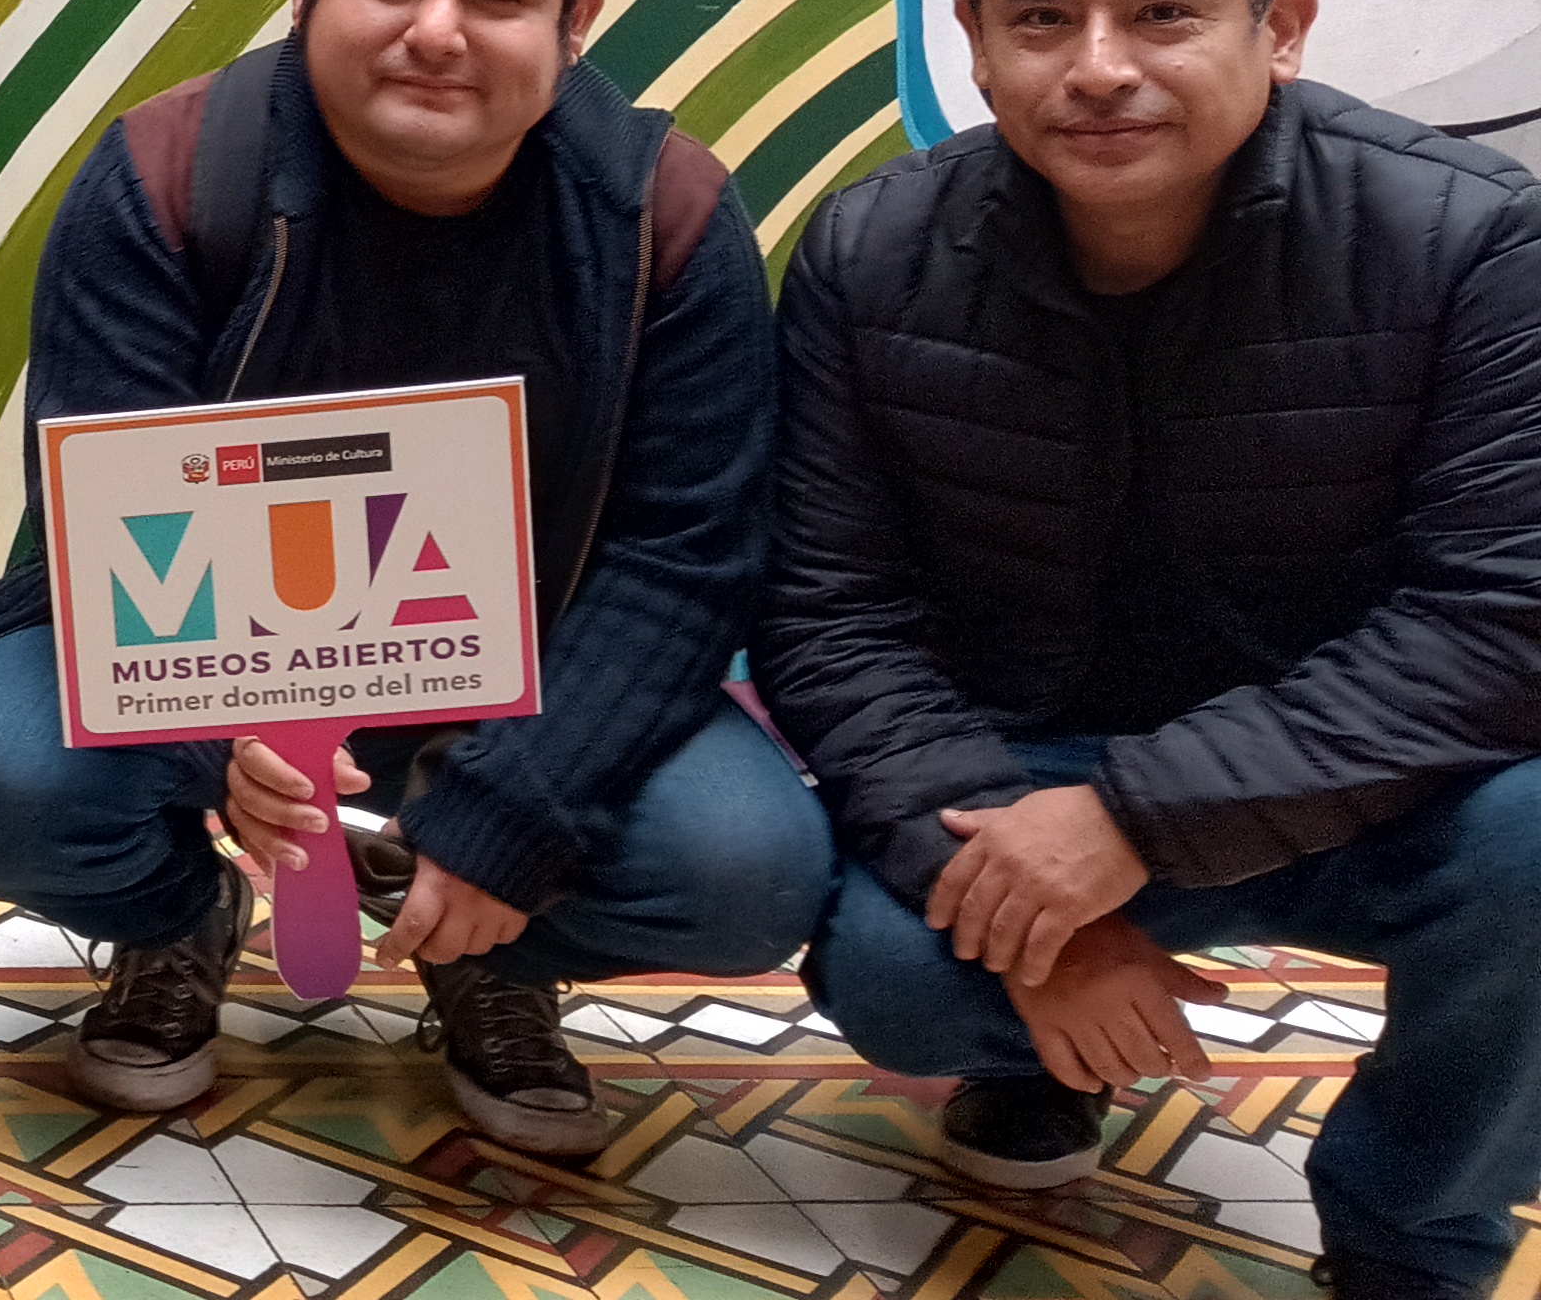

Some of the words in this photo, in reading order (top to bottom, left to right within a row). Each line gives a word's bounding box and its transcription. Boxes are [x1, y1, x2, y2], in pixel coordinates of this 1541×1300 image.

[221, 455, 256, 473] PERÚ
[265, 451, 323, 468] Ministerio
[324, 449, 341, 463] de
[341, 448, 384, 462] Cultura
[109, 492, 480, 648] MUA
[112, 651, 271, 685] MUSEOS
[287, 634, 481, 672] ABIERTOS
[117, 694, 214, 716] Primer
[222, 684, 356, 708] domingo
[367, 672, 412, 698] del
[421, 673, 482, 694] mes
